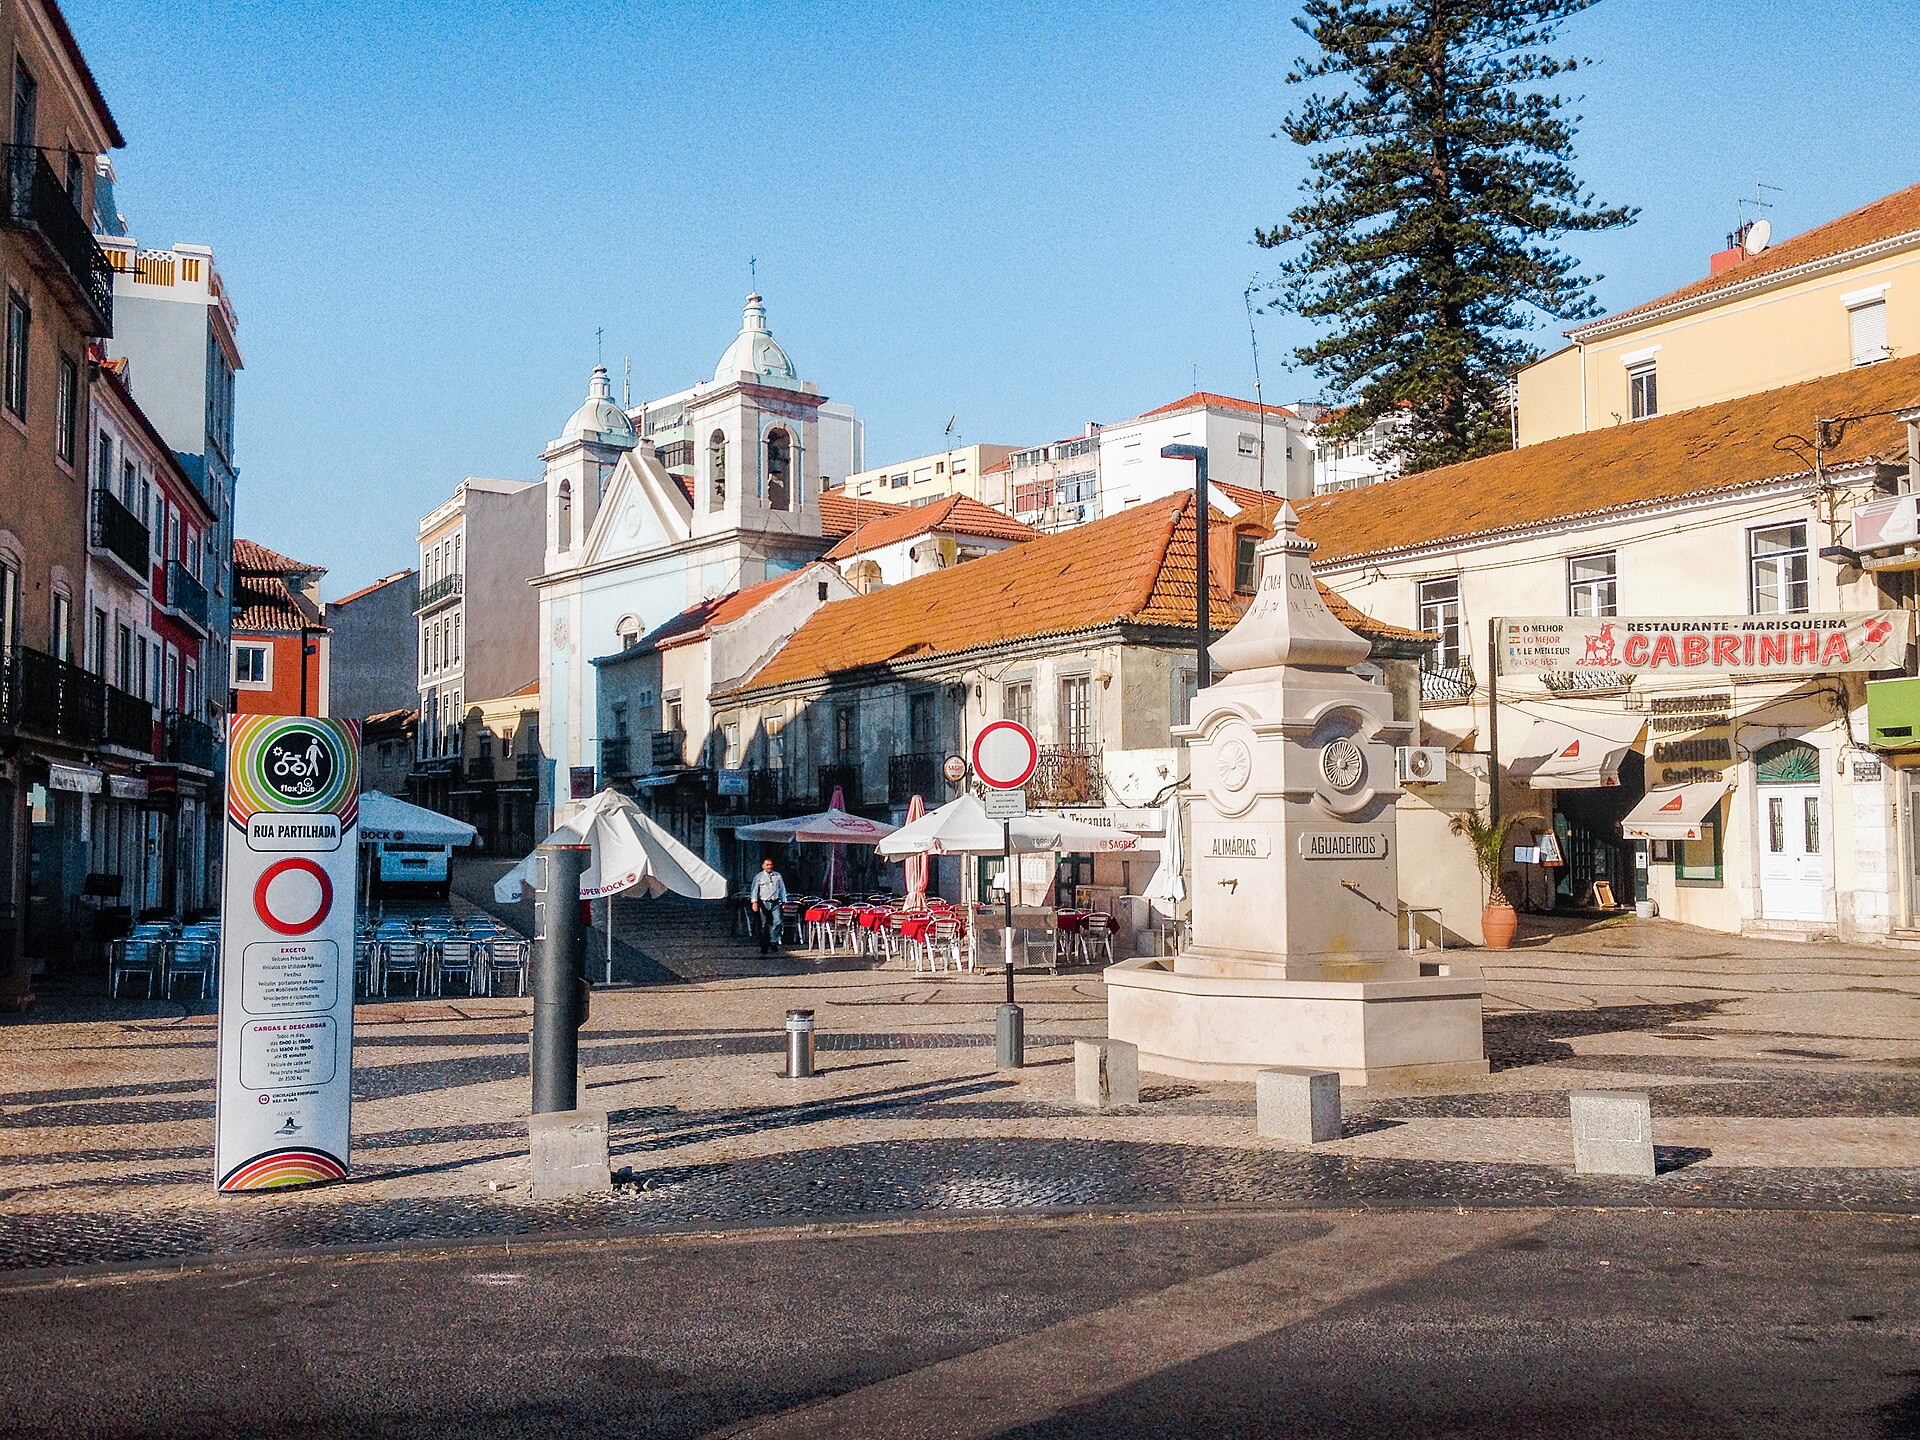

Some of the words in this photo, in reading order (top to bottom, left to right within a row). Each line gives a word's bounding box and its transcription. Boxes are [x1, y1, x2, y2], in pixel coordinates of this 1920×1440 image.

[1264, 575, 1281, 591] CMA
[1290, 573, 1312, 590] CMA
[1522, 625, 1529, 633] O
[1531, 624, 1564, 633] MELHOR
[1627, 622, 1729, 632] RESTAURANTE
[1741, 619, 1848, 632] MARISQUEIRA
[1523, 636, 1533, 644] LO
[1535, 635, 1561, 645] MEJOR
[1523, 647, 1532, 655] LE
[1534, 647, 1570, 655] MEILLEUR
[1623, 631, 1851, 668] CABRINHA
[1069, 813, 1112, 827] Tricanita
[253, 825, 275, 838] RUA
[278, 825, 337, 838] PARTILHADA
[361, 831, 390, 839] BOCK
[1109, 840, 1136, 849] SAGRES
[1212, 835, 1257, 856] ALIMÁRIAS
[1311, 836, 1376, 854] AGUADEIROS
[600, 880, 625, 893] BOCK
[288, 1022, 327, 1031] DESCARGAS
